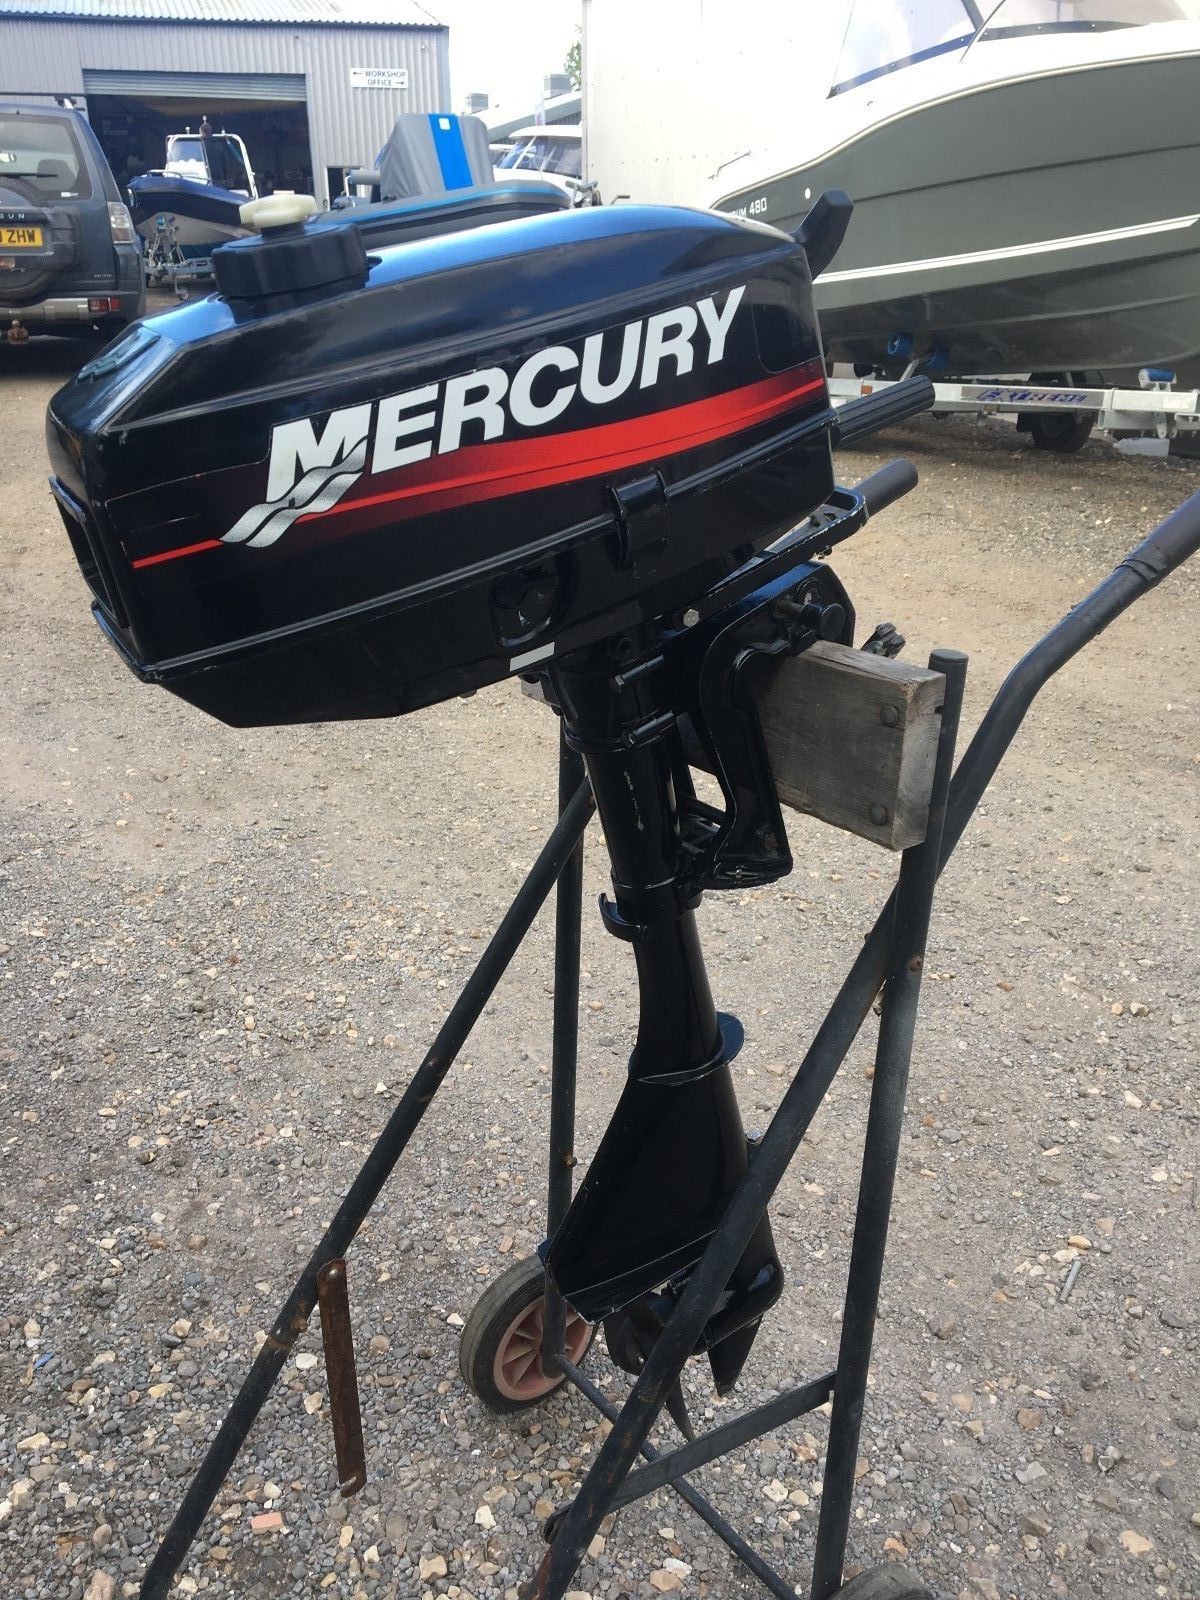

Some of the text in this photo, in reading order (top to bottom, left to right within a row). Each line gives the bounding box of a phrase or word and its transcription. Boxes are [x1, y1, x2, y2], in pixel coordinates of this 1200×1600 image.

[749, 198, 767, 215] 480
[6, 229, 35, 243] ZHW
[266, 285, 746, 503] MERCURY
